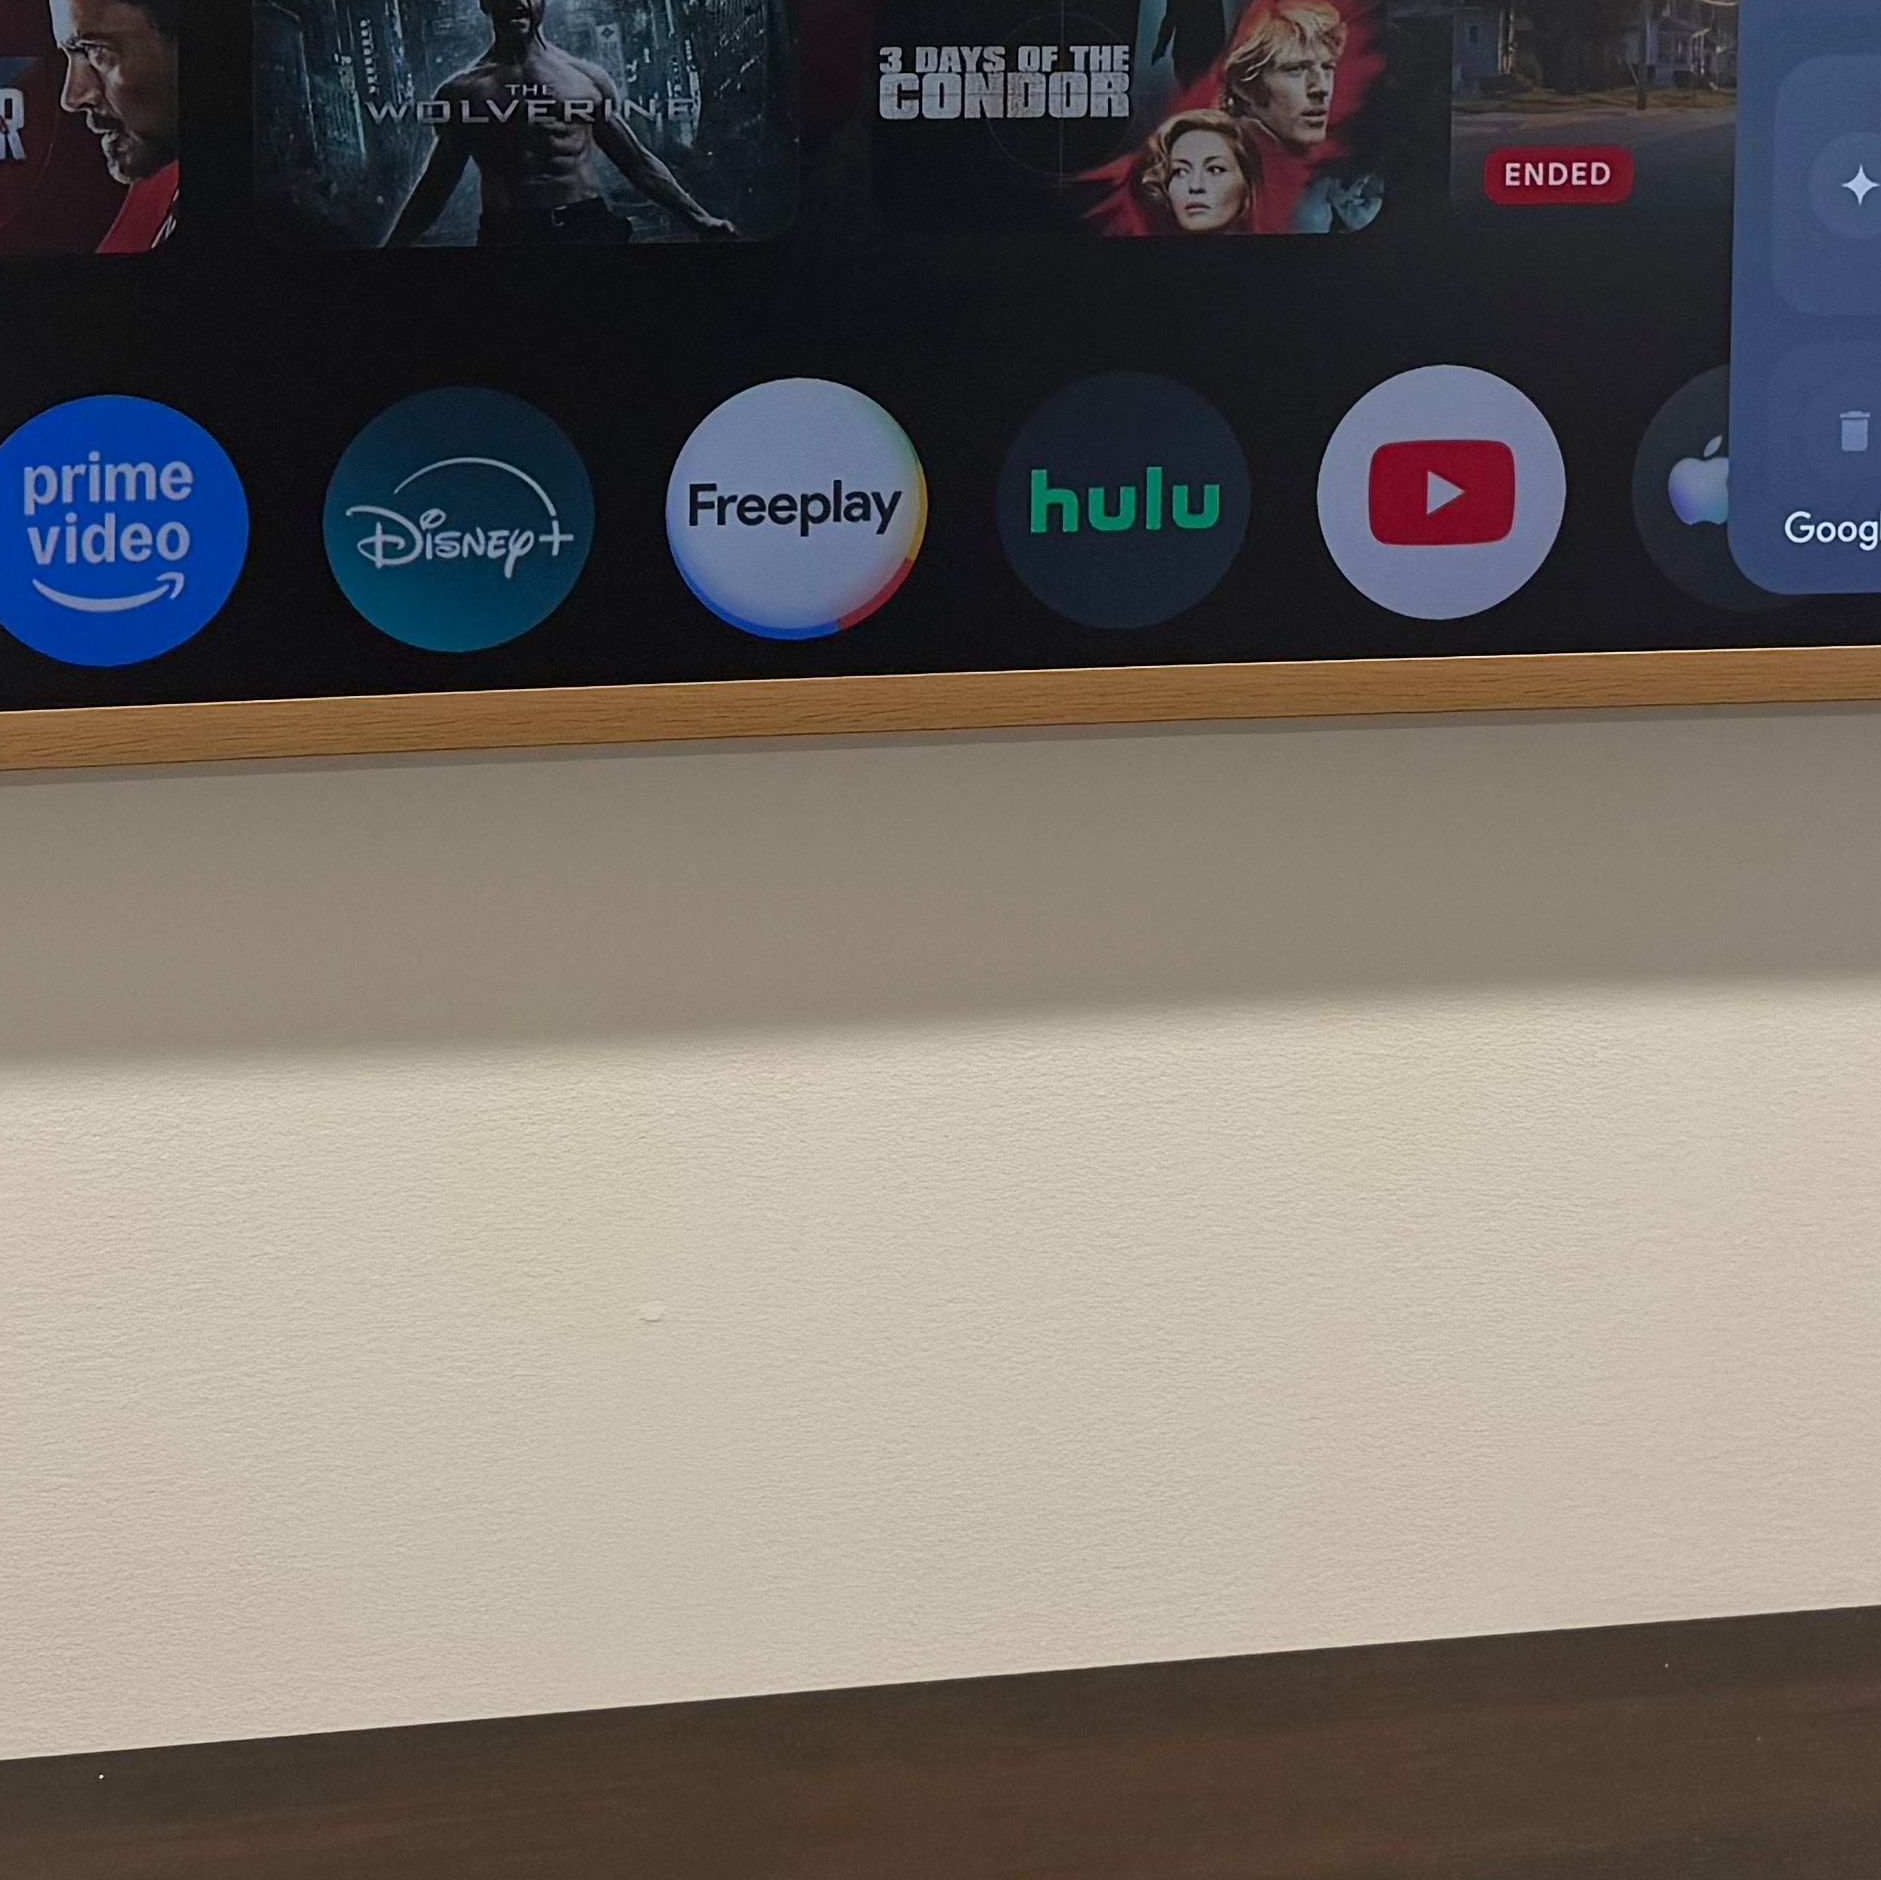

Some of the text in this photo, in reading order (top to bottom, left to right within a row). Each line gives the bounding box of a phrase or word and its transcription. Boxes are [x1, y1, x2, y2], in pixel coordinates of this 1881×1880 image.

[878, 46, 1130, 74] 3 DAYS OF THE
[365, 98, 699, 123] WOLVERINE
[505, 84, 553, 96] THE
[879, 72, 1131, 119] CONDOR
[1505, 162, 1612, 188] ENDED
[23, 451, 193, 516] prime
[1030, 467, 1221, 532] hulu
[688, 480, 902, 538] Freeplay
[29, 512, 190, 566] video
